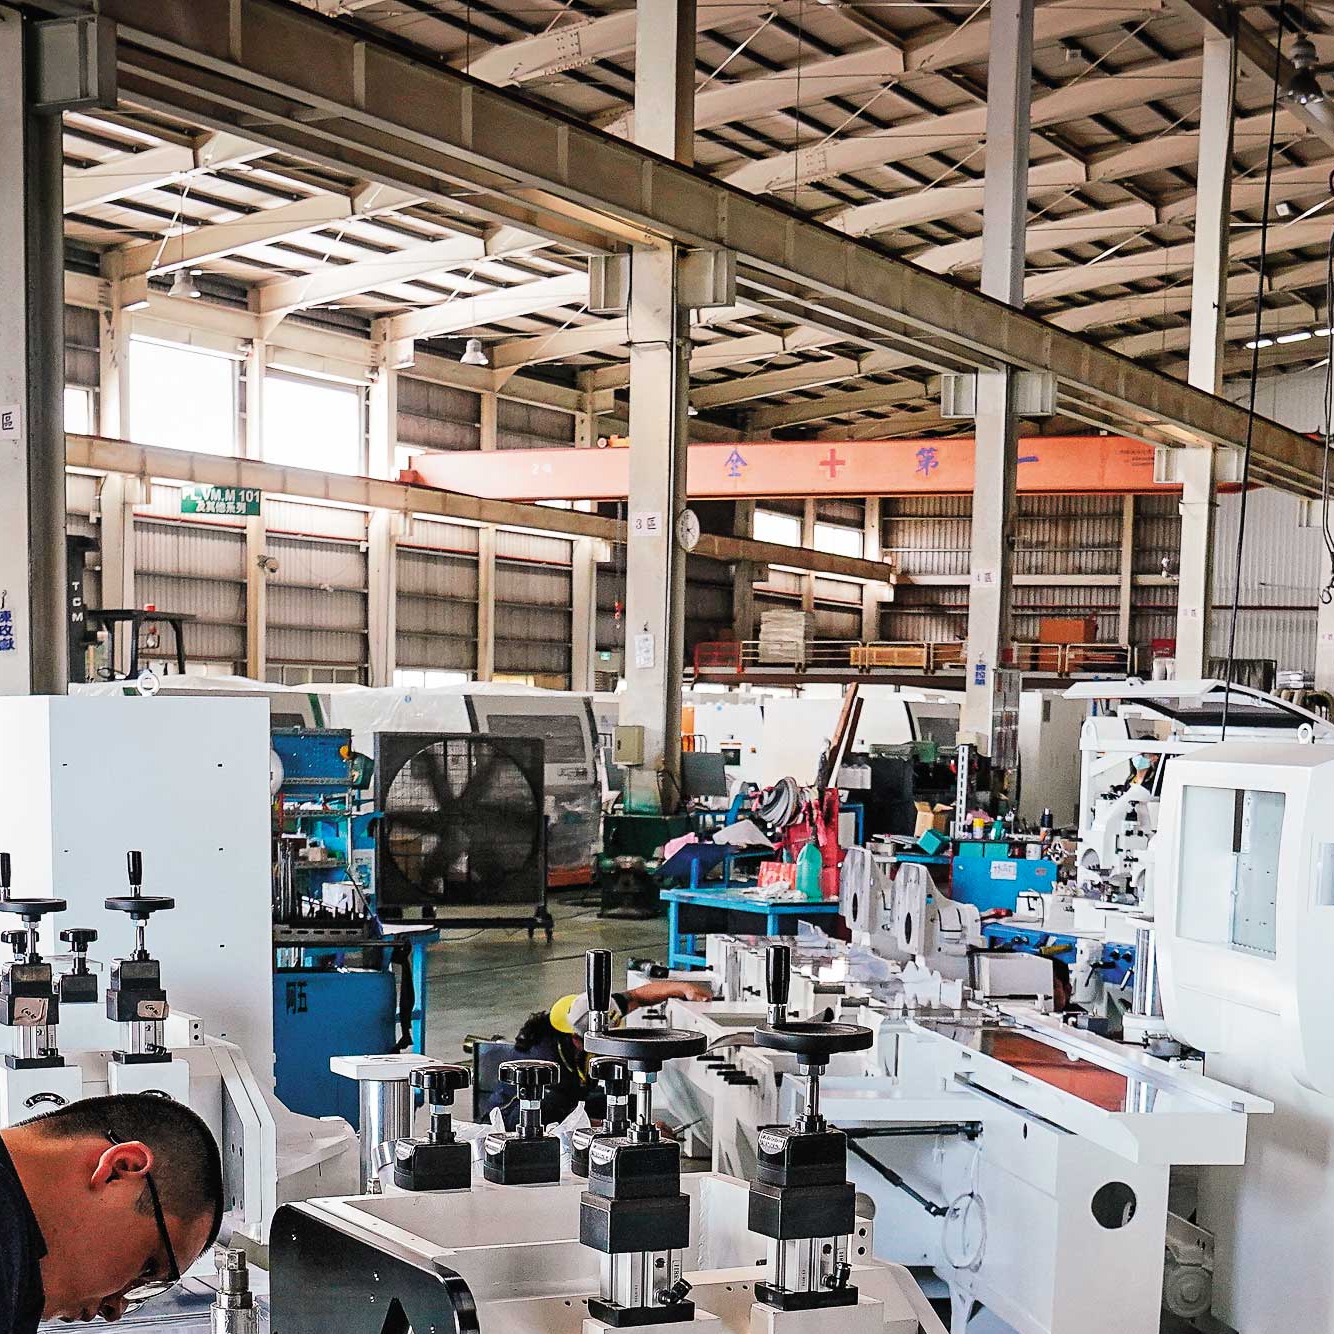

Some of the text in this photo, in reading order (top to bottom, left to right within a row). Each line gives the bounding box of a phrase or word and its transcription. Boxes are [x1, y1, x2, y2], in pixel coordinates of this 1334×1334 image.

[1, 411, 14, 431] 區
[238, 489, 260, 503] 101
[195, 501, 247, 513] 及其他系列
[635, 518, 642, 530] 3
[71, 581, 84, 622] TCM
